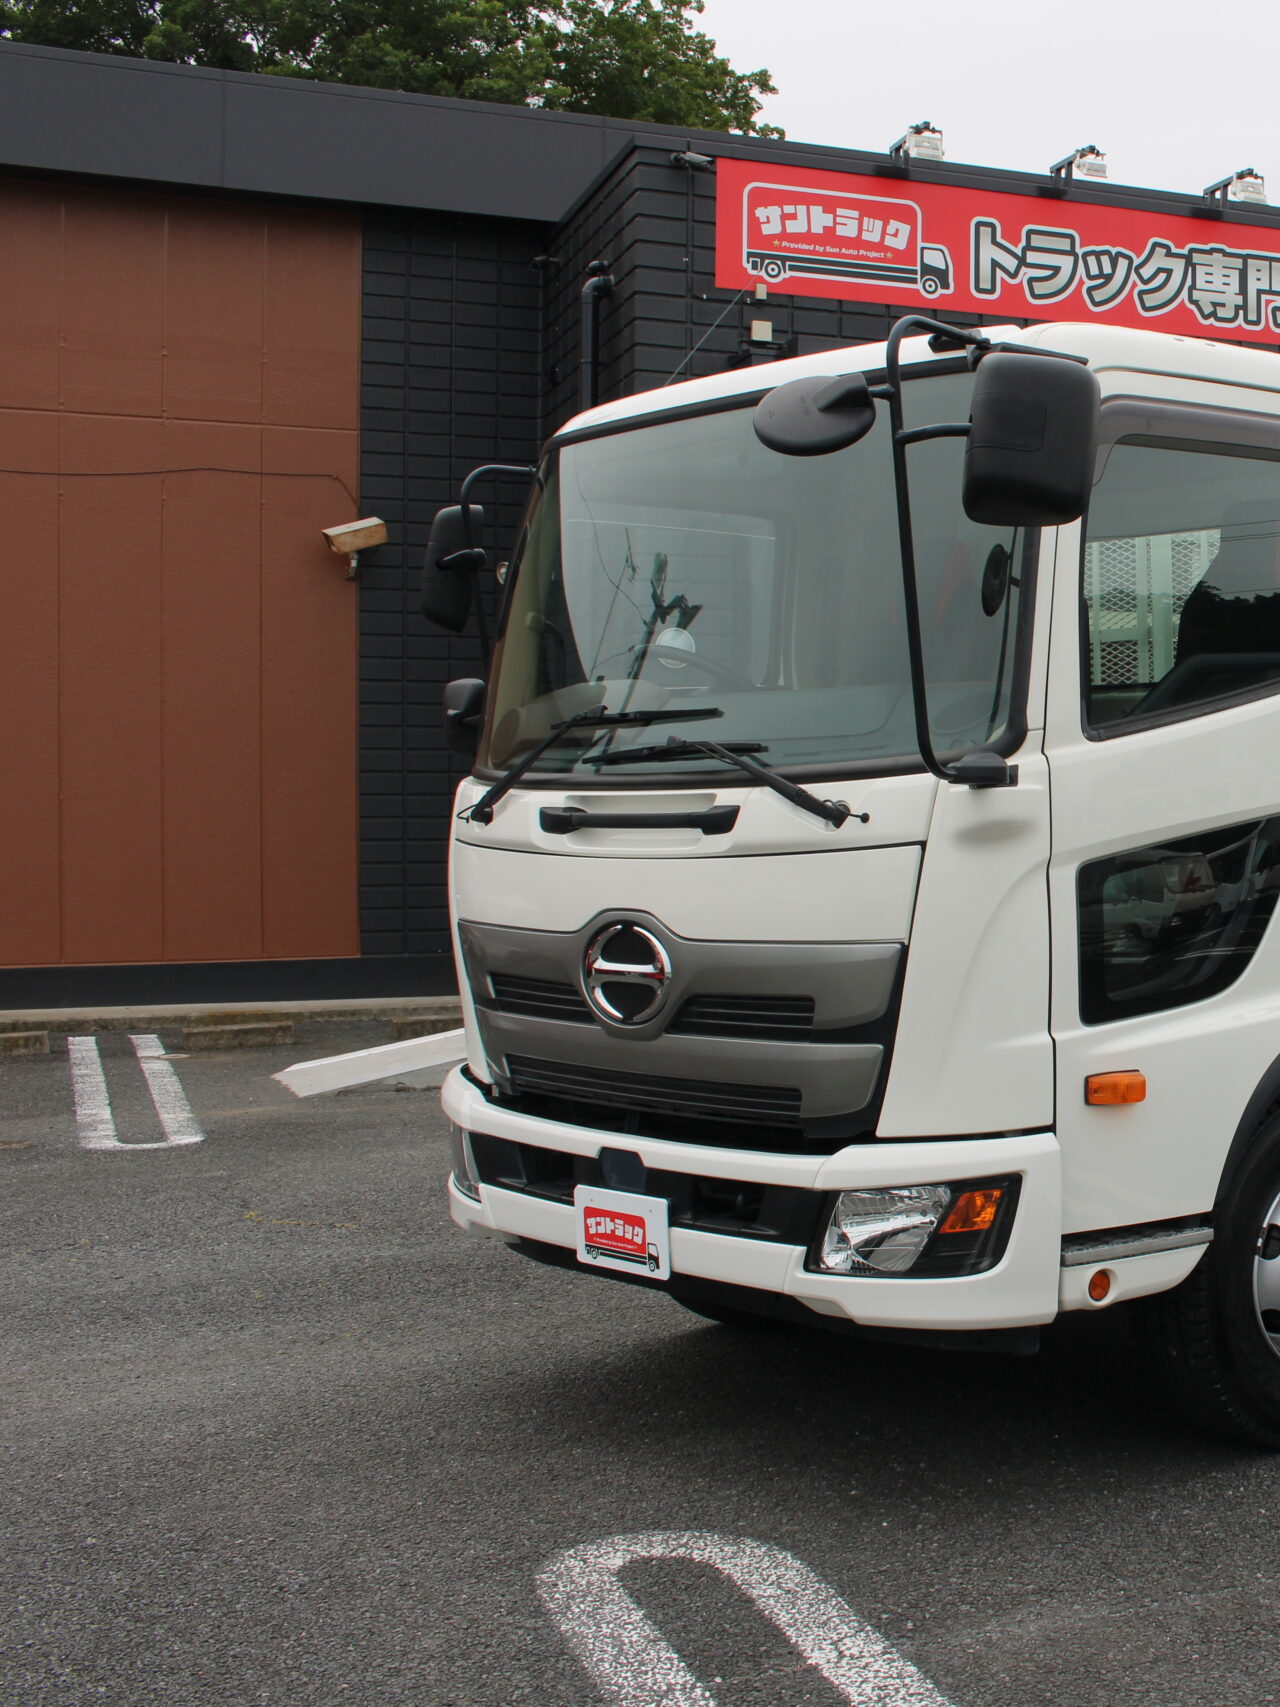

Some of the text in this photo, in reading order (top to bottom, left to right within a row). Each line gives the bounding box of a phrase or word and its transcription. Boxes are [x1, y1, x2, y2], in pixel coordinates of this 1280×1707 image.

[755, 205, 911, 250] サントラック
[782, 241, 885, 258] Provided by Sun Auto Project
[586, 1216, 643, 1245] サントラック
